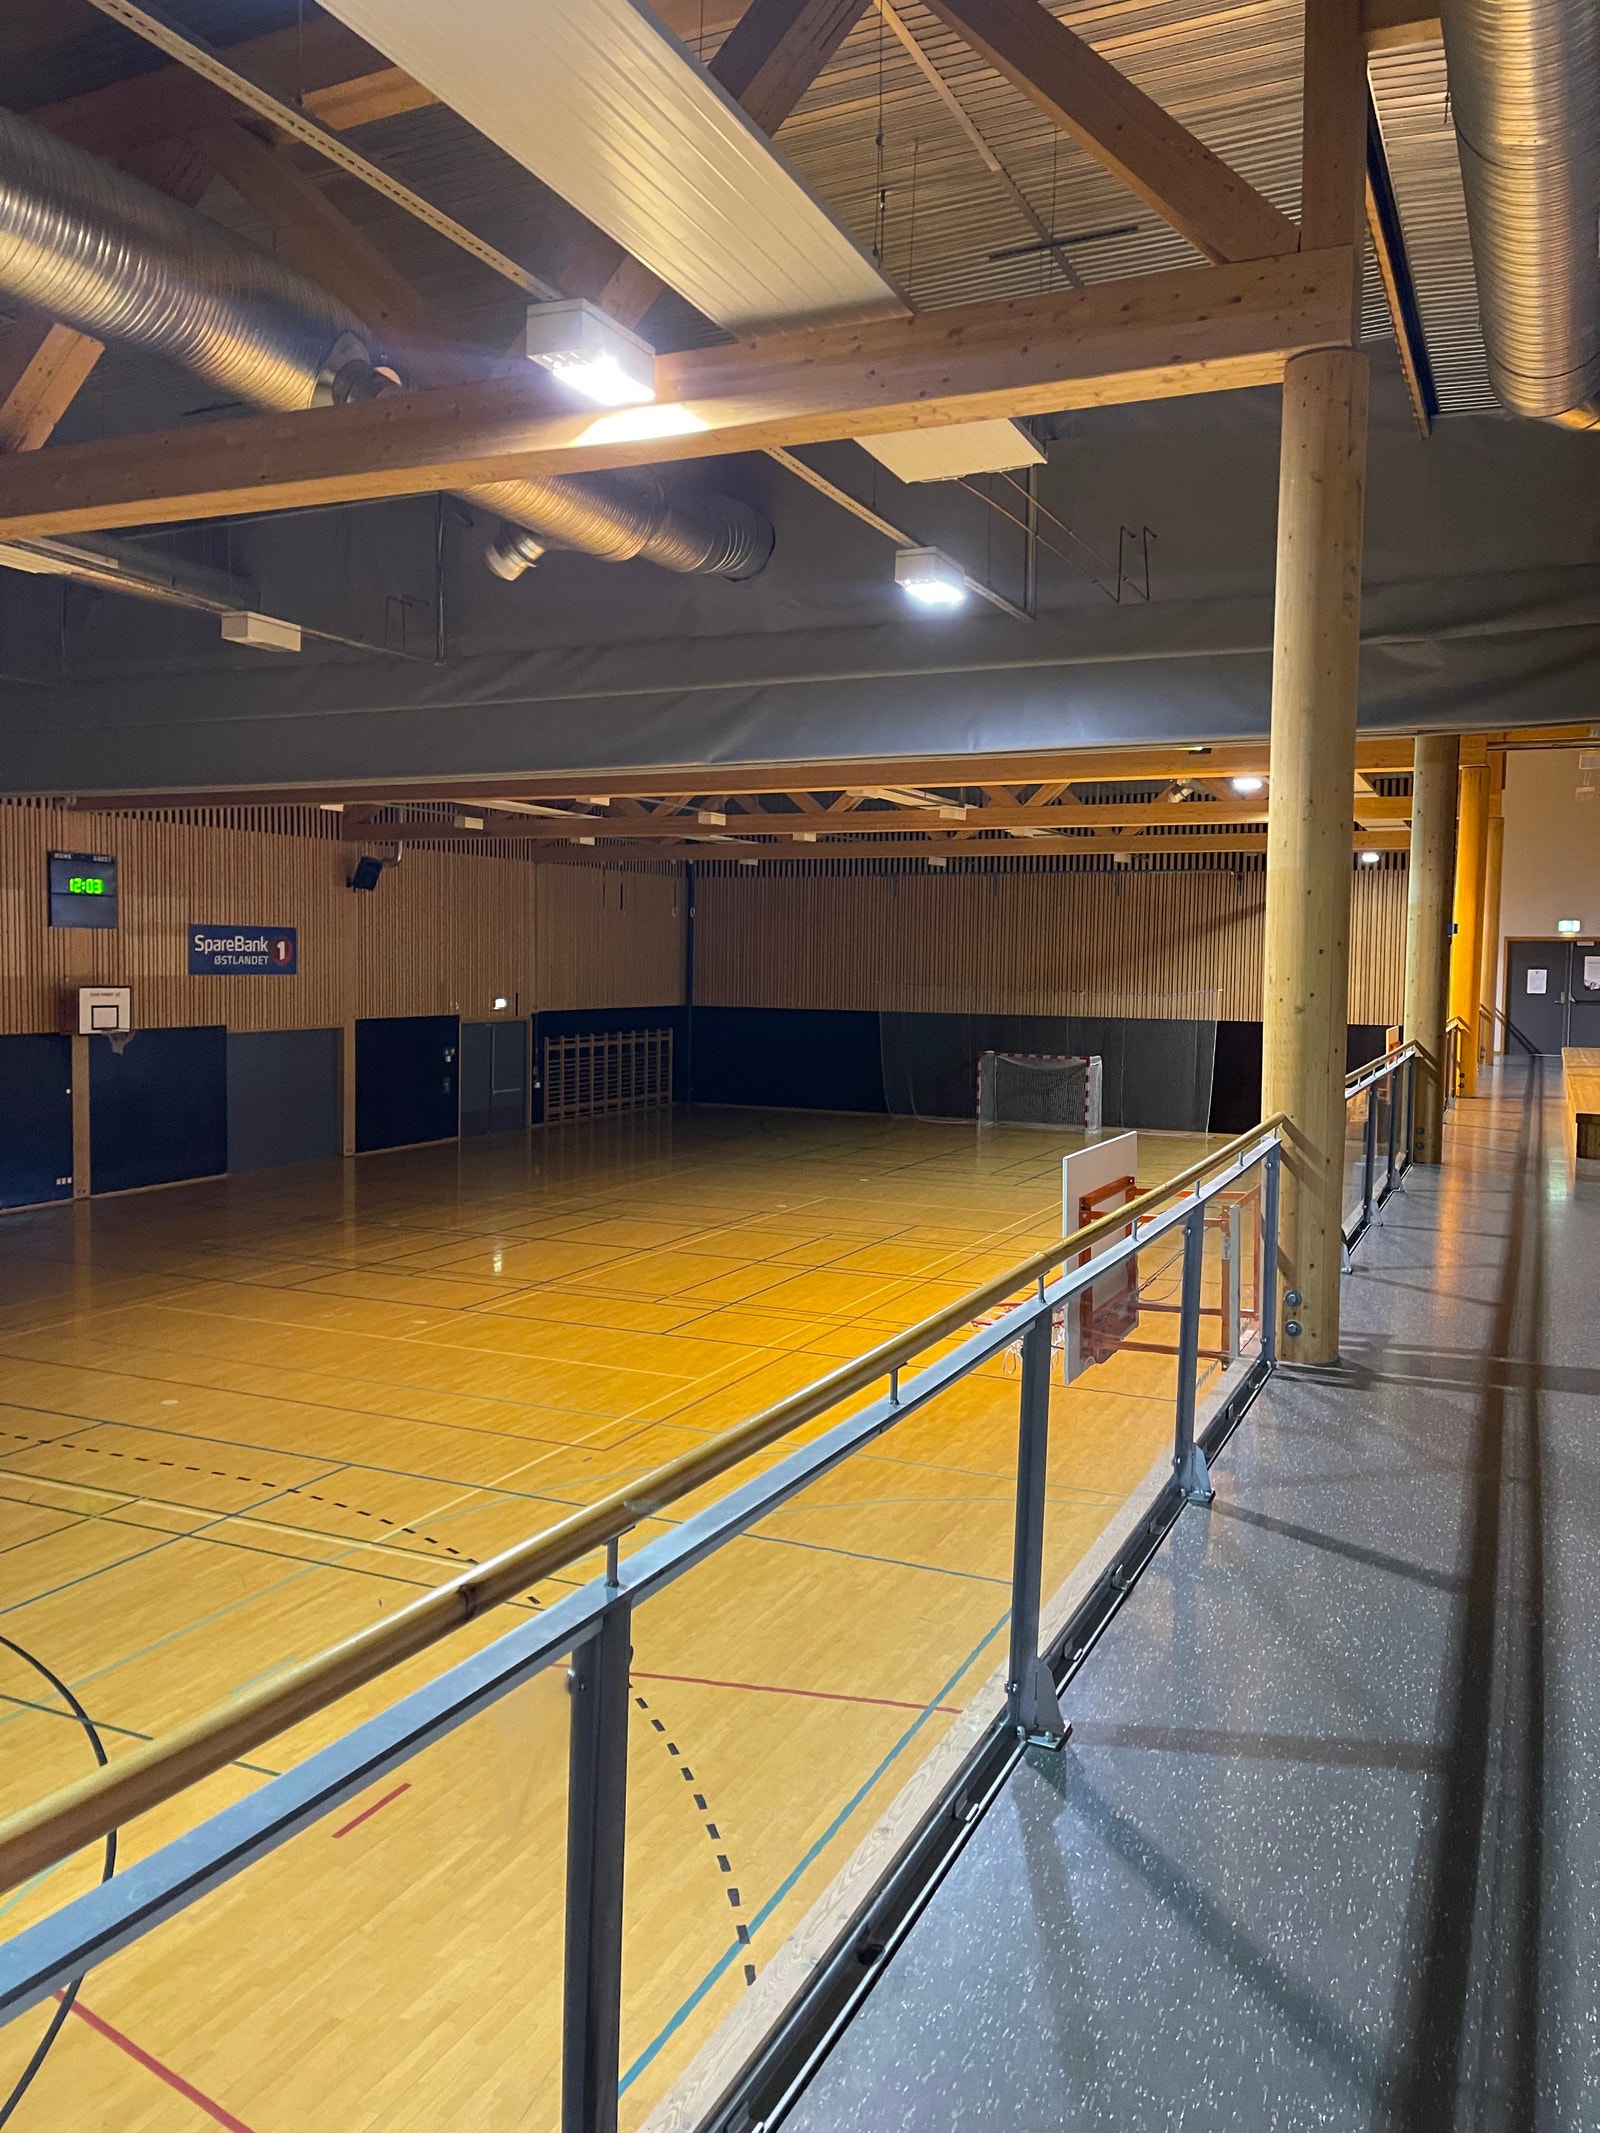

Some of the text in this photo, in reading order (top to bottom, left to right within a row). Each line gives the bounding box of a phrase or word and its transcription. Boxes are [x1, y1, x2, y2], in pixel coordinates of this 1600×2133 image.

[69, 877, 103, 894] 12:03
[194, 934, 285, 960] SpareBank 1
[214, 955, 269, 965] ØSTLANDET
